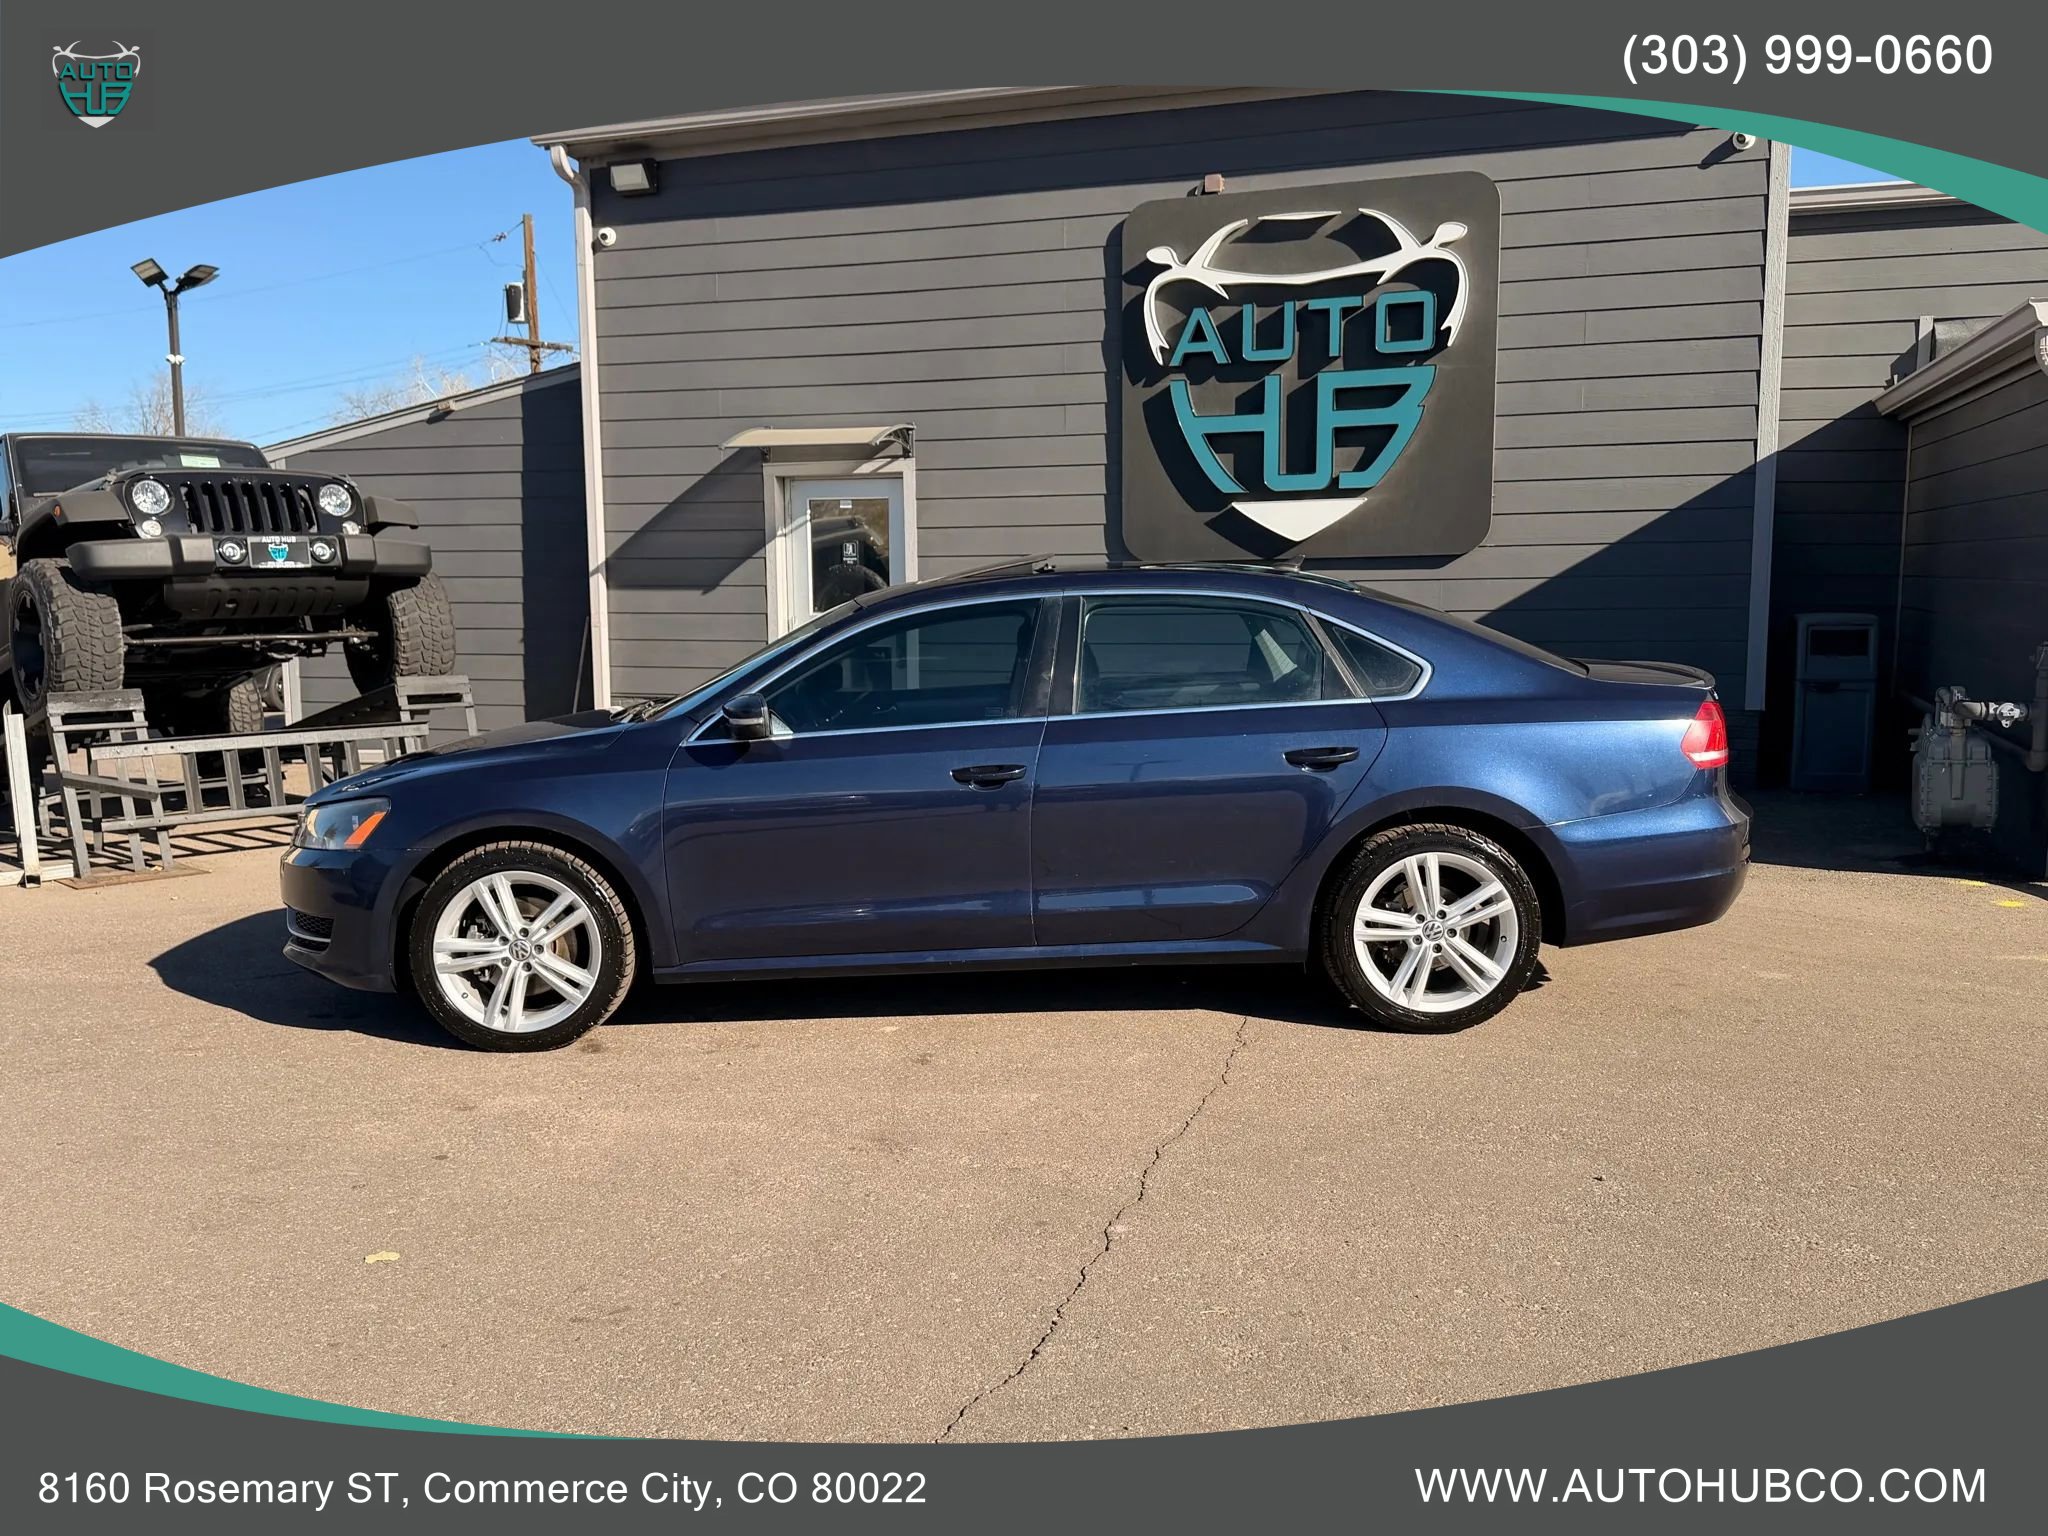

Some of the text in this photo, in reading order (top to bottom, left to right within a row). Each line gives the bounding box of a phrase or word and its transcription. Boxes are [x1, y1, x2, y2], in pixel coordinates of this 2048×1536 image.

[1169, 289, 1437, 367] AUTO
[1170, 365, 1437, 494] HUB
[262, 535, 297, 543] AUTO HUB
